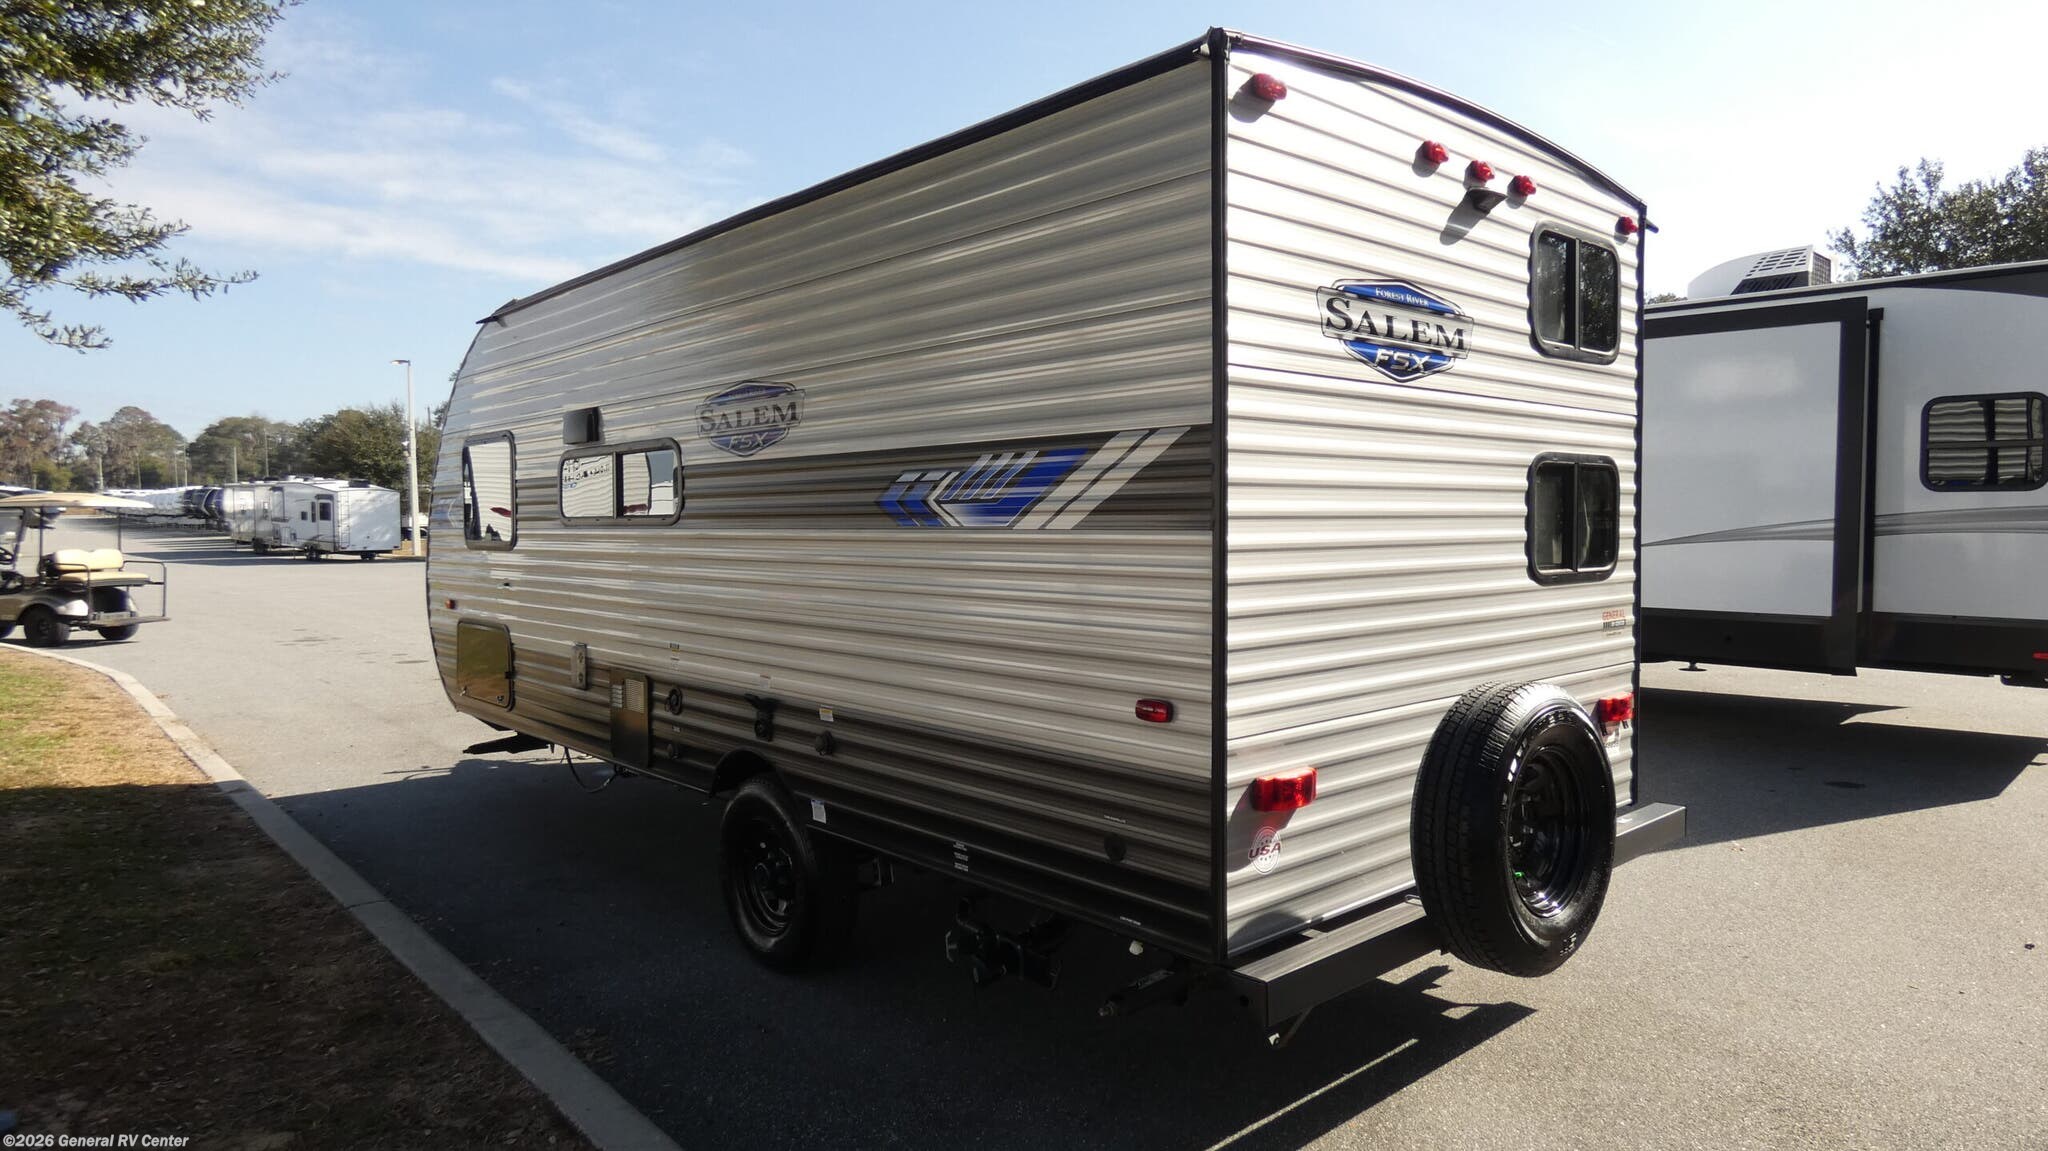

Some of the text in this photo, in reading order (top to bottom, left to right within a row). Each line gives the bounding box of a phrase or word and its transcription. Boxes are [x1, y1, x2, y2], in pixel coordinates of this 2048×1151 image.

[1375, 287, 1429, 307] FOREST RIVER
[1325, 297, 1465, 351] SALEM
[1374, 348, 1431, 373] FSX
[700, 401, 799, 433] SALEM
[728, 431, 769, 450] FSX
[1248, 842, 1281, 859] USA
